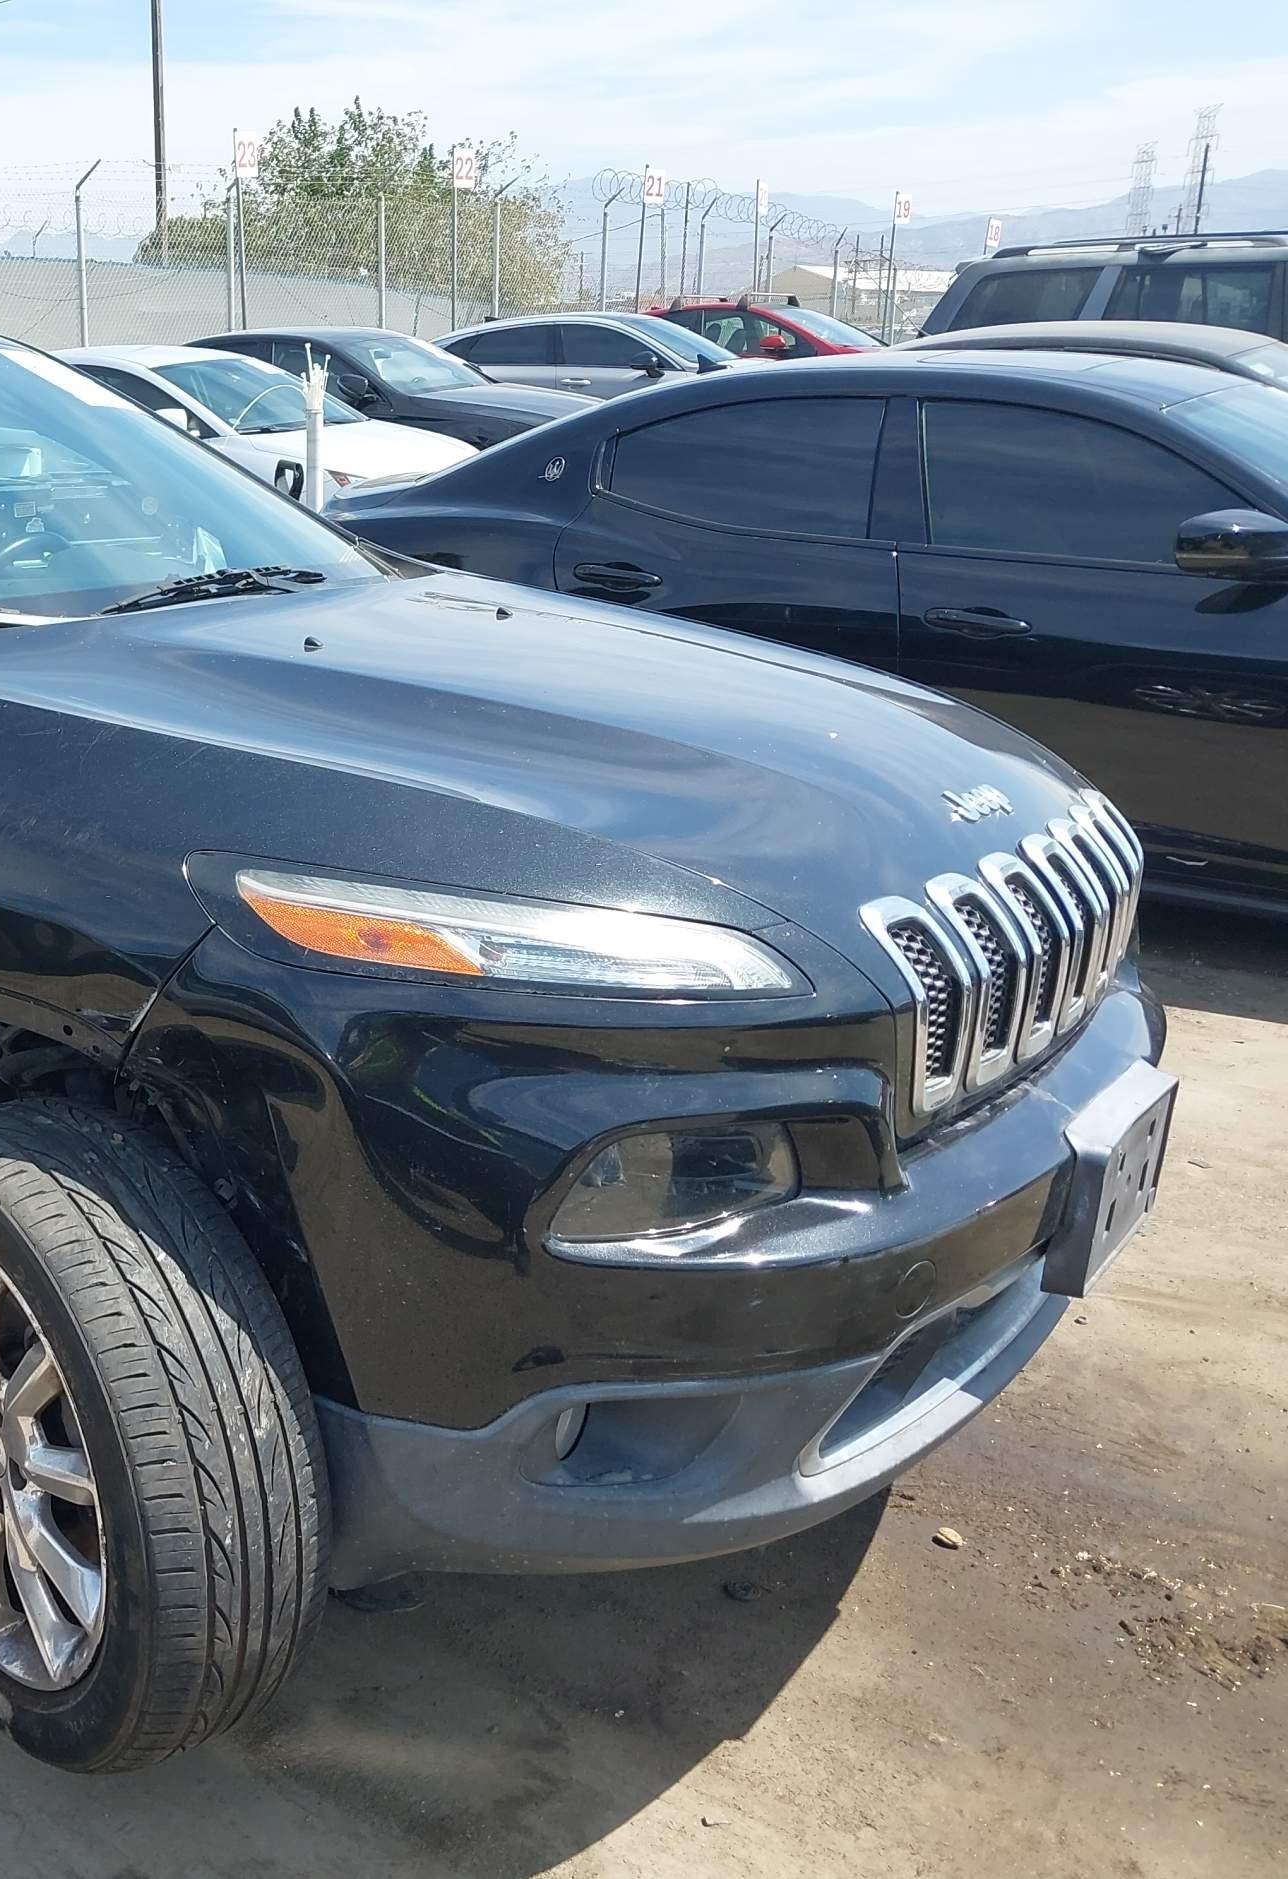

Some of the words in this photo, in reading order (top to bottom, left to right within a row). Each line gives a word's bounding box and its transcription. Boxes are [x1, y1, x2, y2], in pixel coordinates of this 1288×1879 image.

[237, 140, 257, 169] 23
[455, 156, 474, 181] 22
[646, 174, 664, 198] 21
[896, 200, 911, 219] 19
[988, 224, 1000, 243] 18
[940, 783, 1015, 824] Jeep
